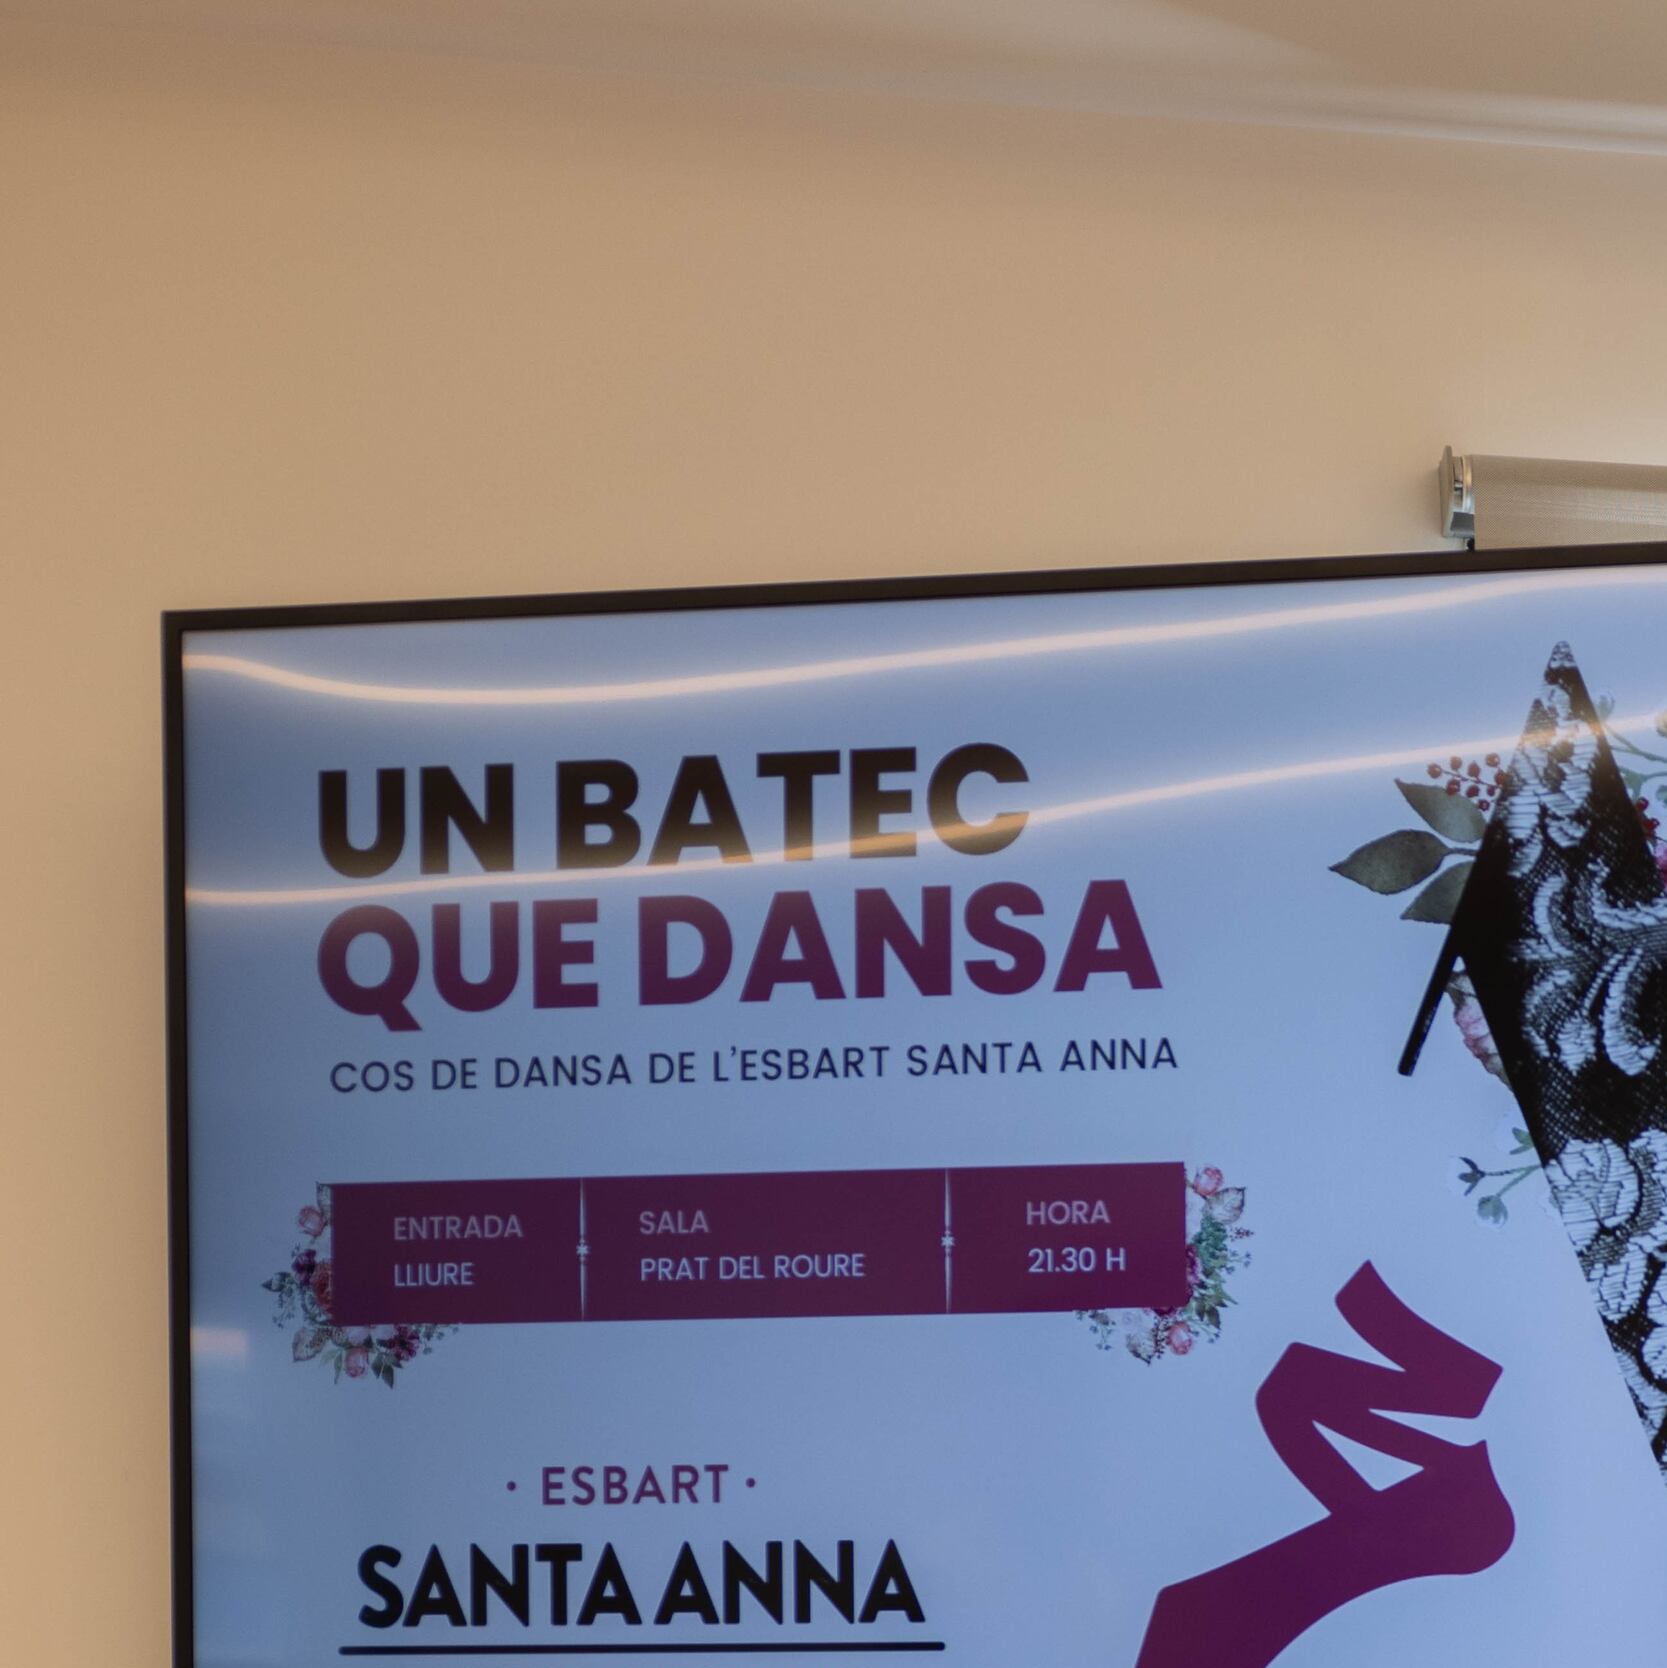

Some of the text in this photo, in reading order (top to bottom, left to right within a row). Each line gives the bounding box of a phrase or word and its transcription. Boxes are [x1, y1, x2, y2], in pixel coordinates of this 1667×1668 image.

[317, 742, 1031, 879] UN BATEC
[316, 878, 1164, 1032] QUE DANSA
[329, 1060, 415, 1094] COS
[431, 1058, 479, 1091] DE
[494, 1053, 632, 1088] DANSA
[649, 1051, 697, 1085] DE
[906, 1041, 1043, 1076] SANTA
[1059, 1036, 1179, 1072] ANNA
[639, 1209, 710, 1235] SALA
[1026, 1199, 1112, 1226] HORA
[393, 1214, 524, 1241] ENTRADA
[640, 1253, 866, 1281] PRAT DEL ROURE
[1027, 1246, 1126, 1273] 21.30 H
[394, 1262, 475, 1287] LLIURE
[541, 1464, 729, 1506] ESBART
[357, 1539, 926, 1630] SANTA ANNA
